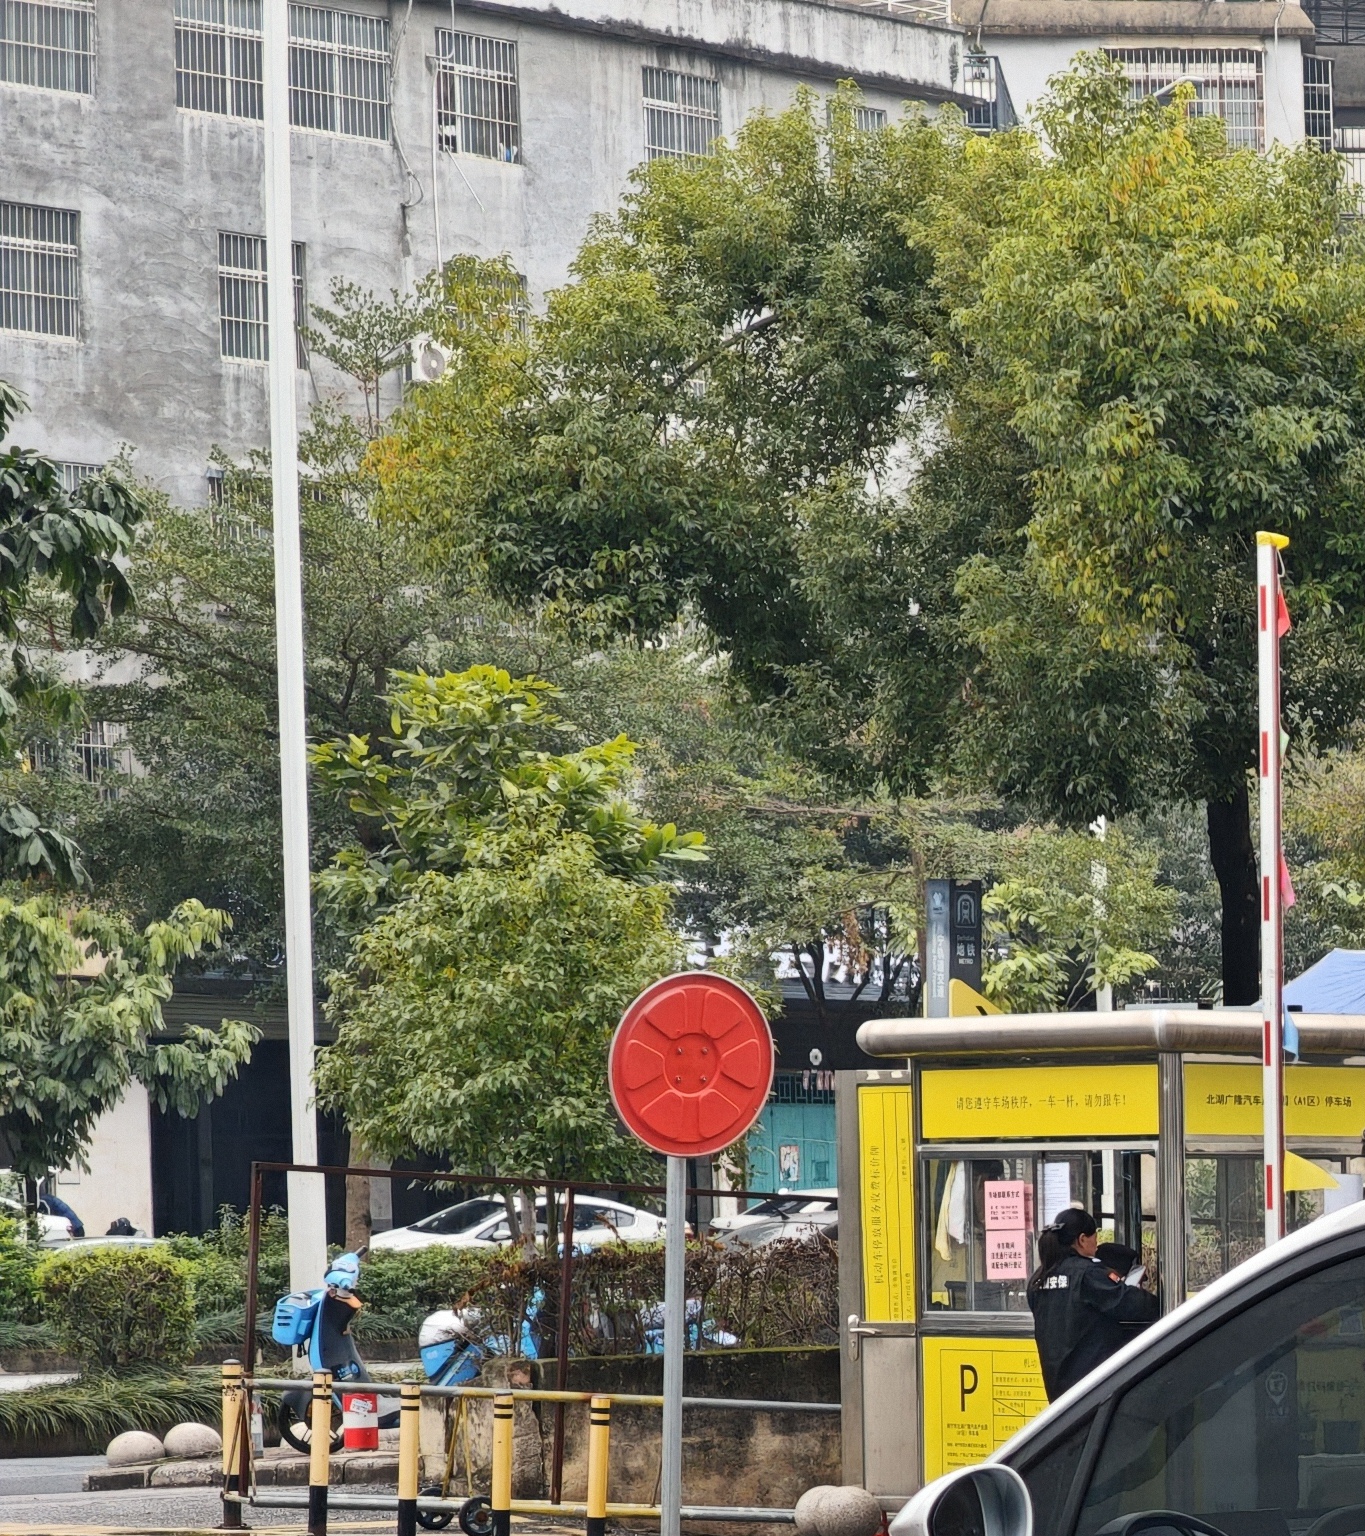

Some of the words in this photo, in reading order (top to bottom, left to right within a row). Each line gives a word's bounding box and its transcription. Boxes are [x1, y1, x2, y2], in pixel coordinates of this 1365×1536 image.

[1206, 1094, 1352, 1108] 北湖广隆汽车（A1区）停车场
[960, 1364, 978, 1412] P
